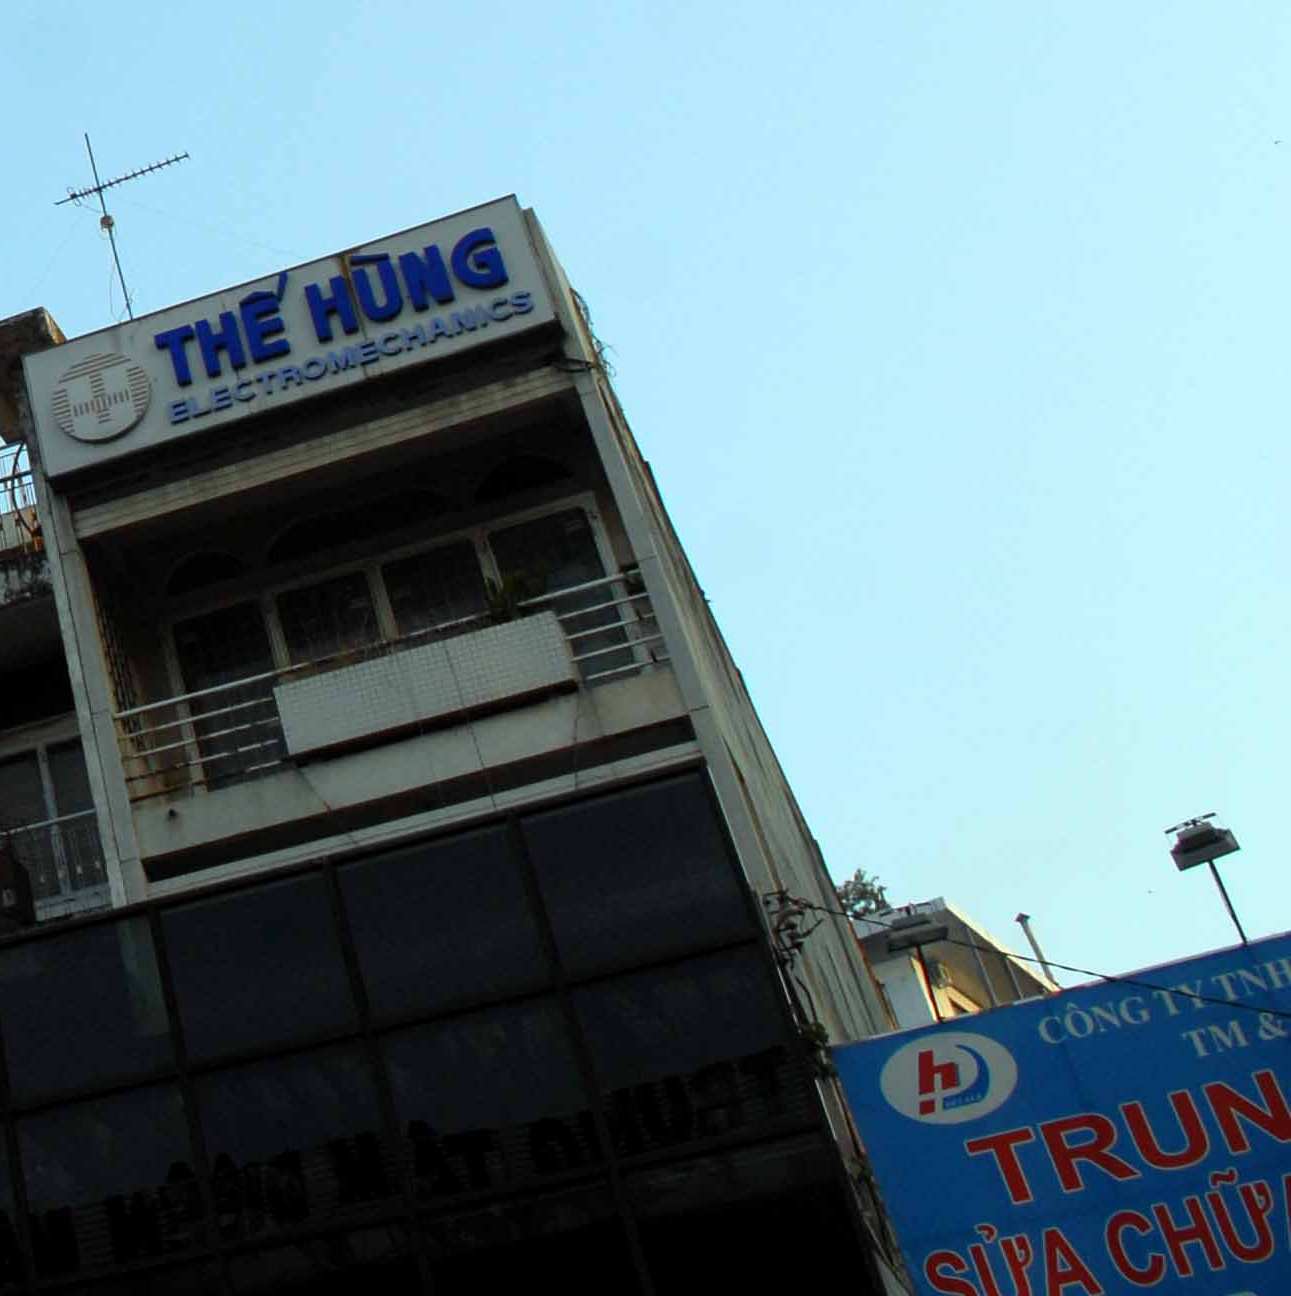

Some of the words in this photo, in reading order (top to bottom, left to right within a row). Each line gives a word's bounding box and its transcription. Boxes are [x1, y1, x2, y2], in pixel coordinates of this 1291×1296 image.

[155, 271, 291, 388] THẾ
[304, 227, 511, 344] HÙNG
[167, 289, 536, 425] ELECTROMECHANICS
[1038, 996, 1151, 1045] CÔNG
[1153, 979, 1207, 1017] TY
[1181, 1020, 1250, 1057] TM
[1258, 1011, 1289, 1041] &
[1106, 1166, 1291, 1287] CHỮ
